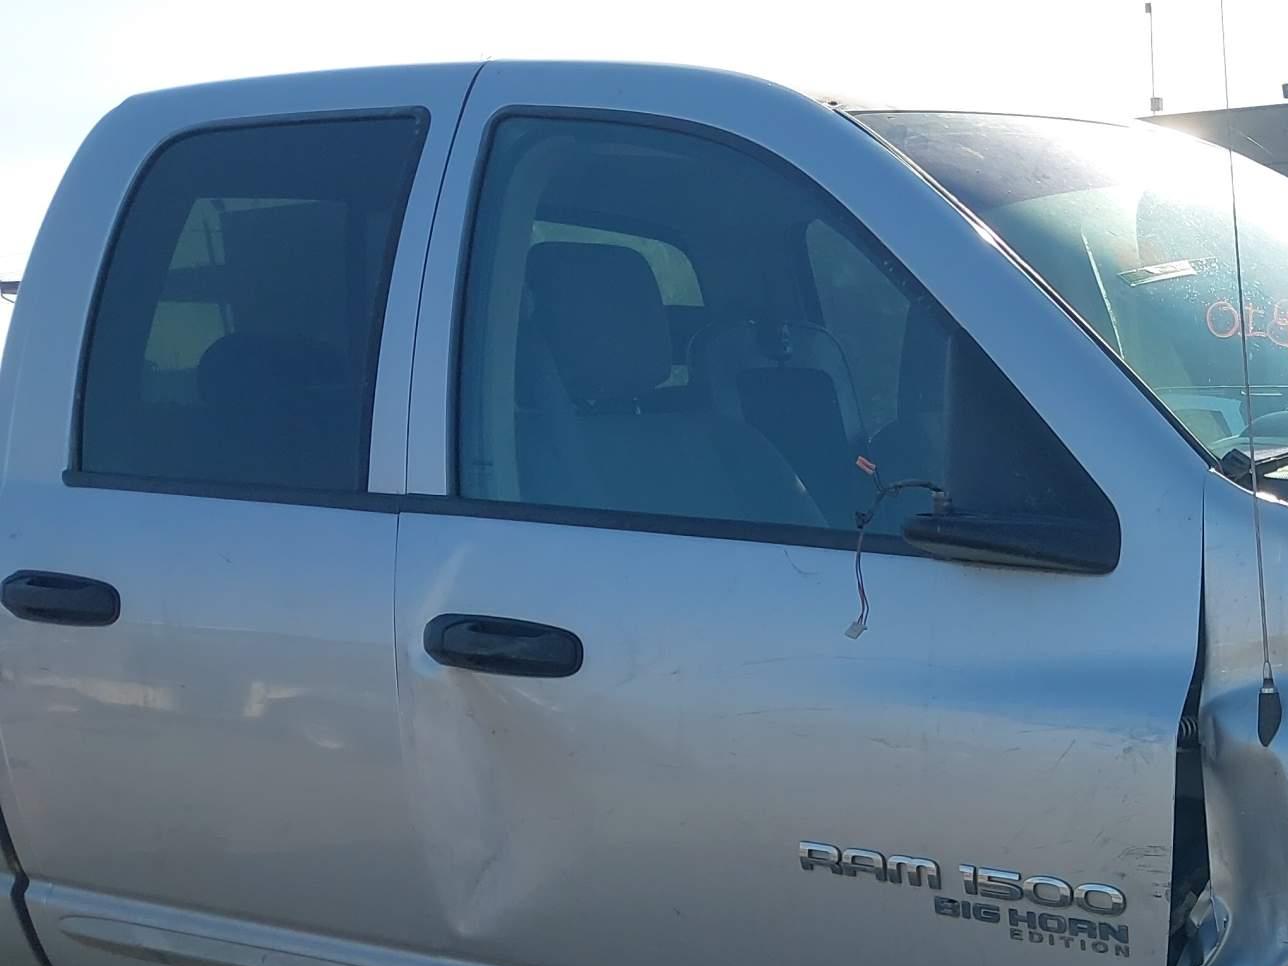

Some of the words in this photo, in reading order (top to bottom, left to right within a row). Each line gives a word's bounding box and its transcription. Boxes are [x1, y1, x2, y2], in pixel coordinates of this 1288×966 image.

[799, 840, 942, 890] RAM
[959, 864, 1127, 917] 1500
[934, 895, 1001, 924] BIG
[1008, 908, 1129, 944] HORN
[1009, 927, 1131, 959] EDITION
